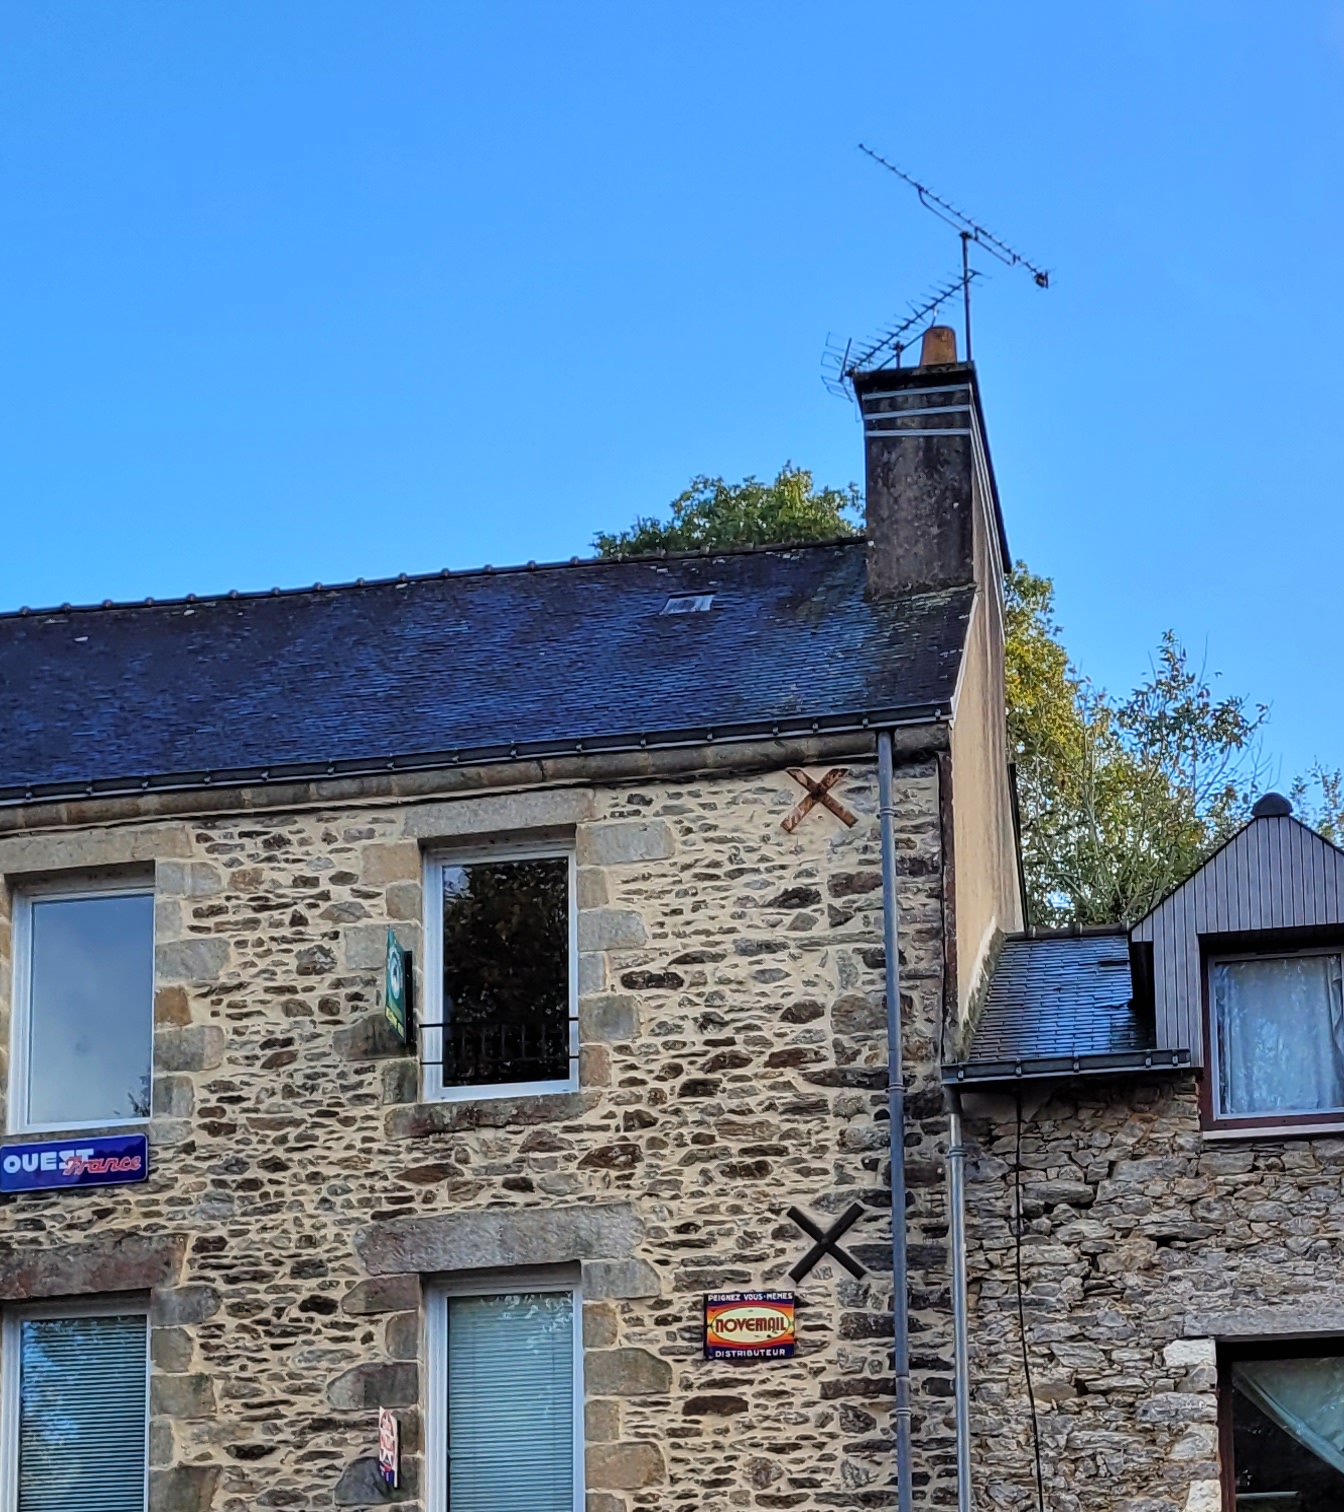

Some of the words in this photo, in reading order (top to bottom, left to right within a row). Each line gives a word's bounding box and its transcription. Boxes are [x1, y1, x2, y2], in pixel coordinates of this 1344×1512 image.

[3, 1147, 94, 1174] OUEST
[62, 1155, 142, 1176] France
[707, 1294, 741, 1302] PEIGNEZ
[714, 1348, 786, 1358] DISTRIBUTEUR
